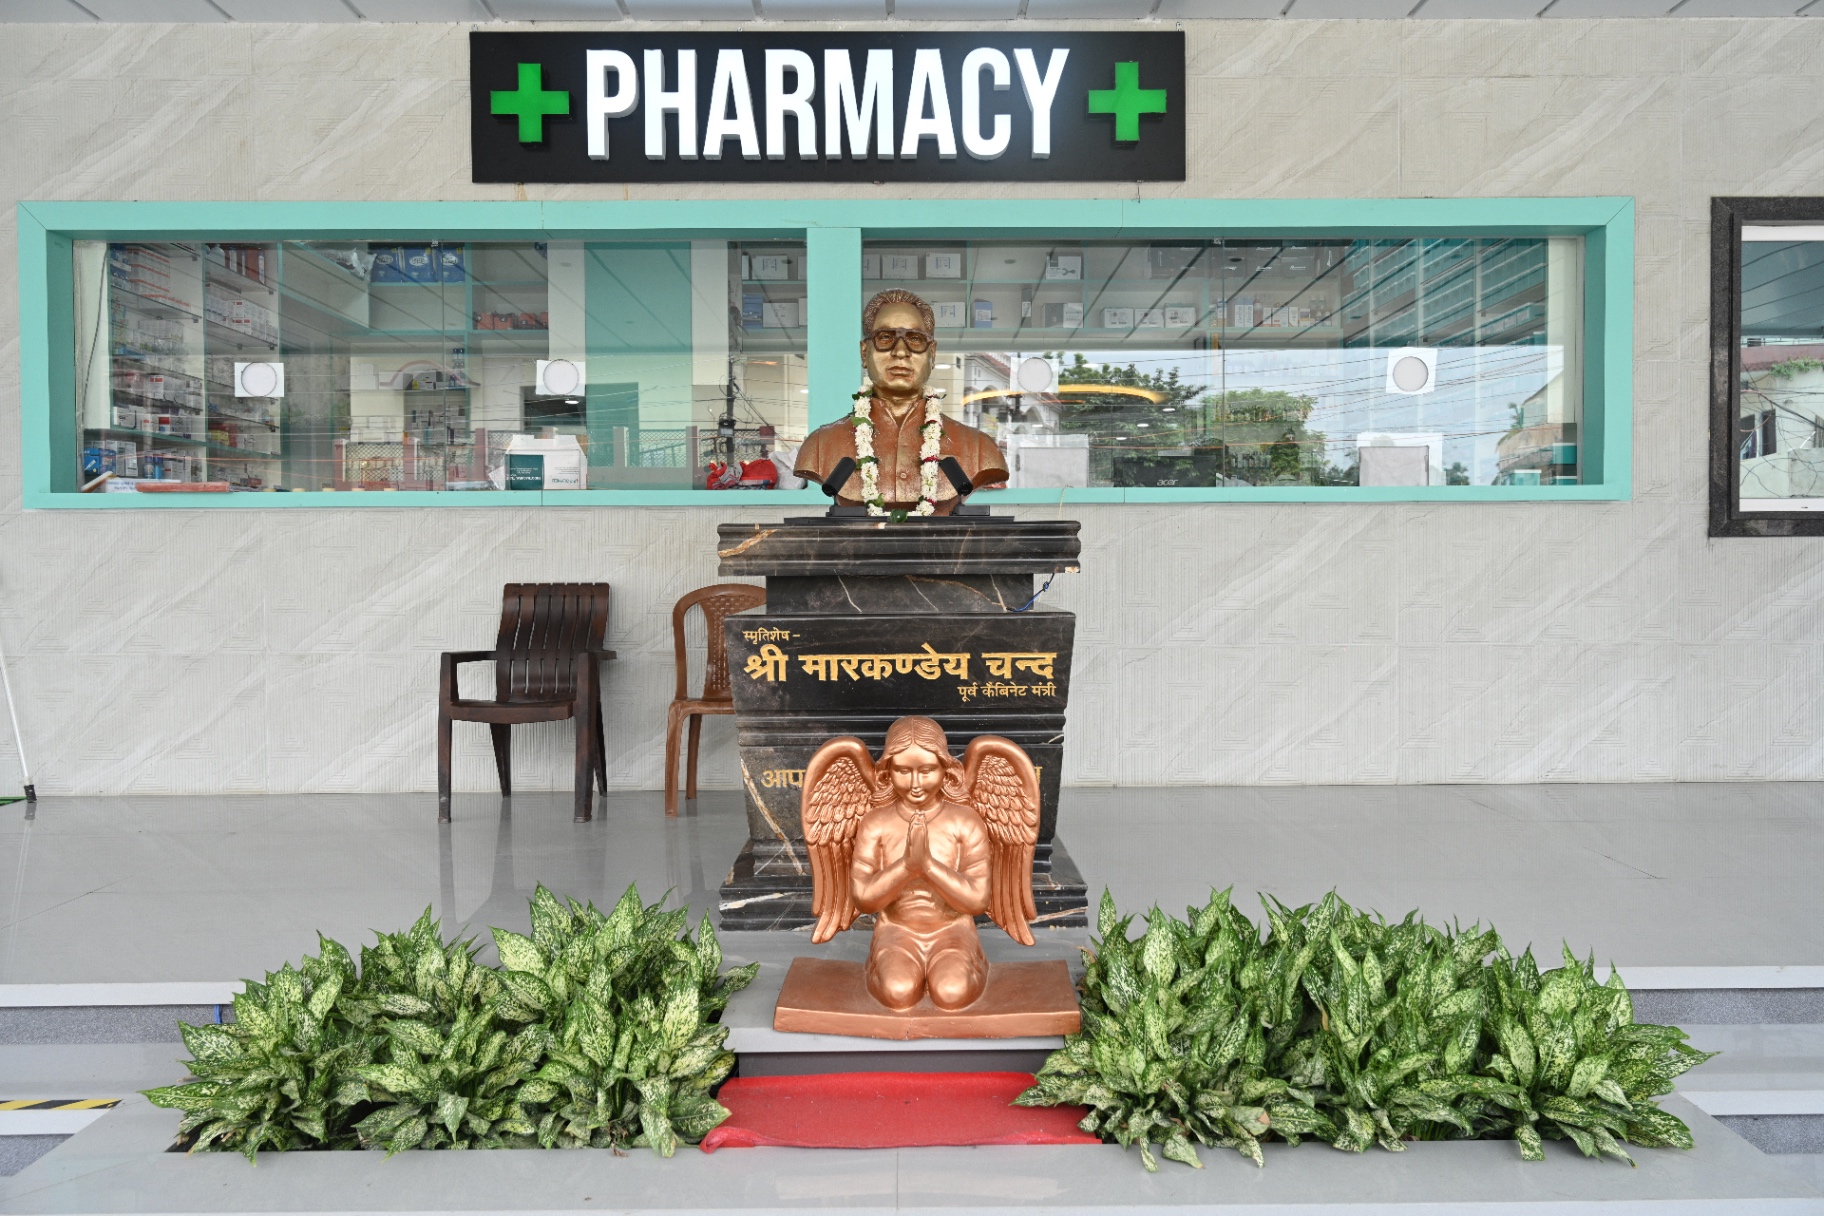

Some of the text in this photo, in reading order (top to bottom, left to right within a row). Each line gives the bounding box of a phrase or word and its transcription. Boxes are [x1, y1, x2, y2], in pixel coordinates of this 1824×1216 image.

[587, 47, 1070, 160] PHARMACY
[1156, 479, 1179, 487] acer
[743, 643, 1057, 682] श्री मारकण्डेय चन्द
[957, 682, 979, 703] पूर्व
[1032, 682, 1057, 697] मंत्री
[761, 769, 806, 790] आप
